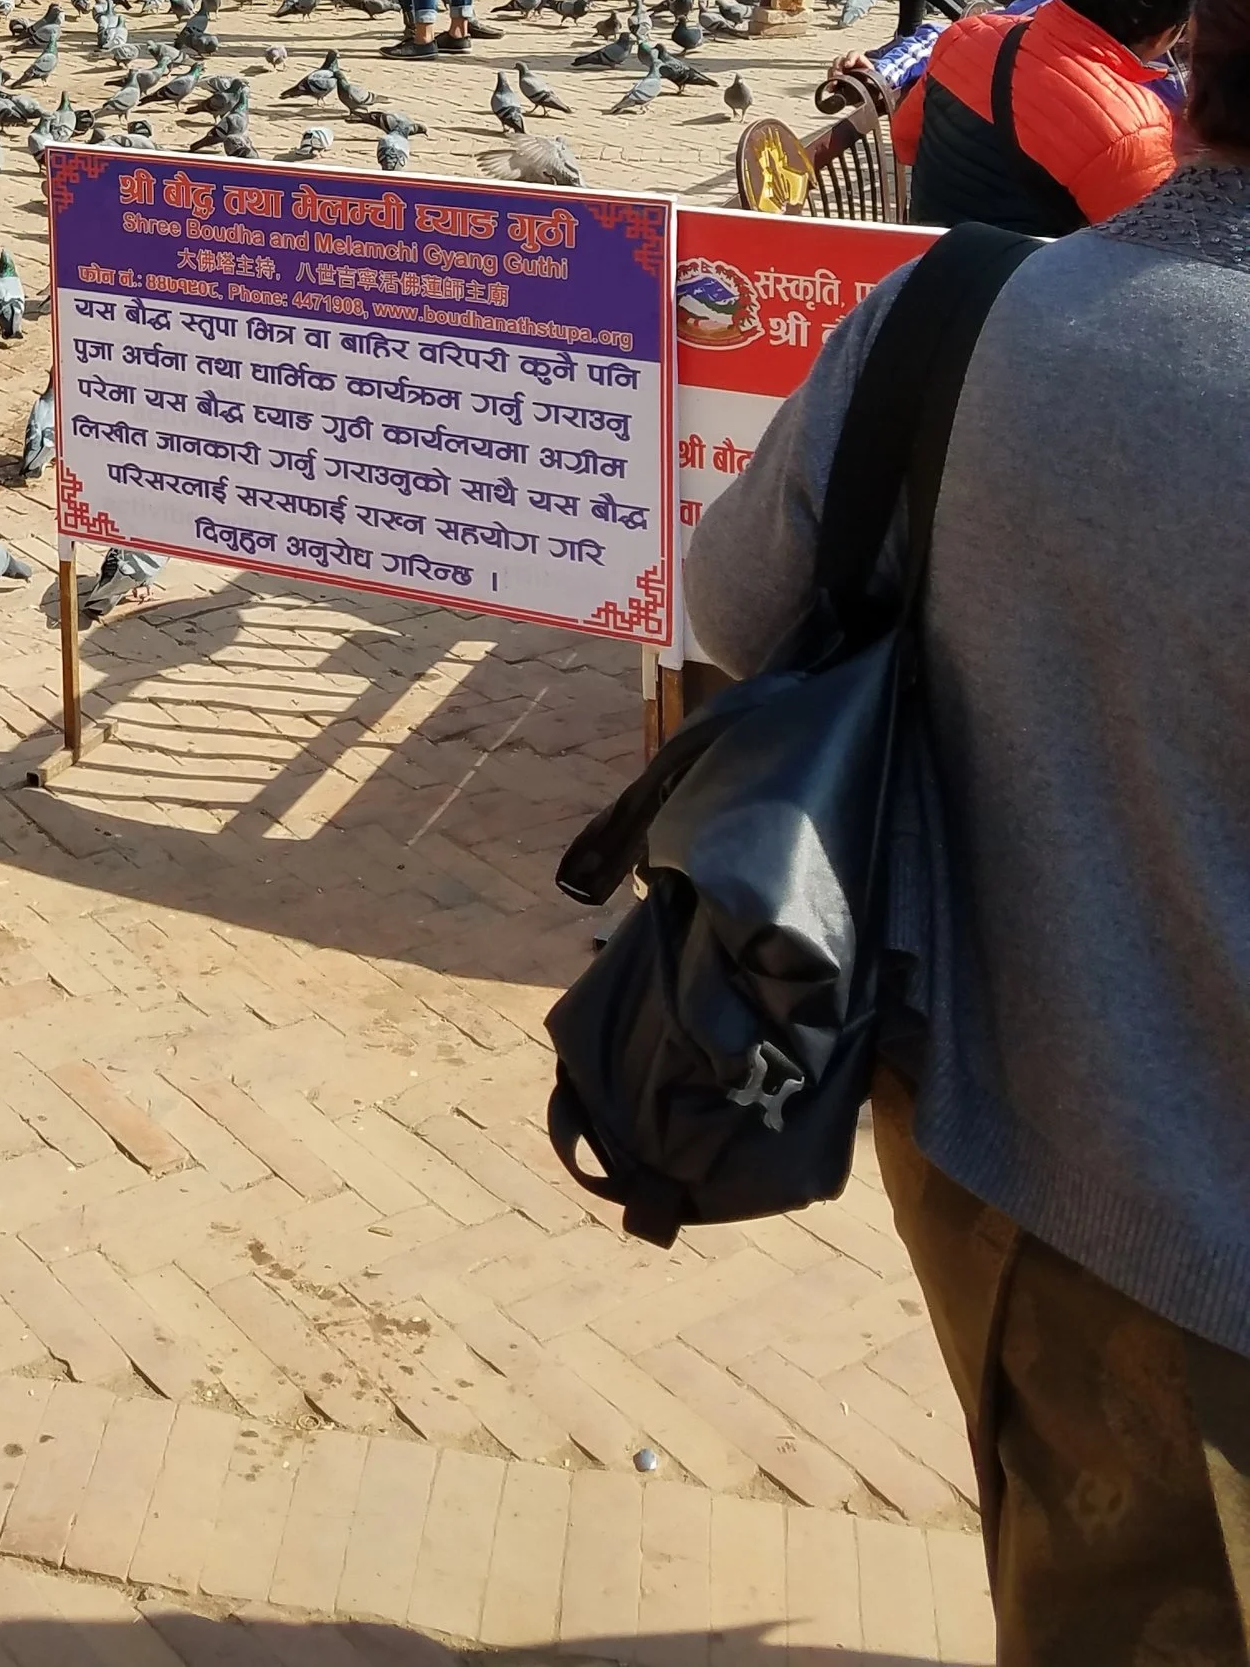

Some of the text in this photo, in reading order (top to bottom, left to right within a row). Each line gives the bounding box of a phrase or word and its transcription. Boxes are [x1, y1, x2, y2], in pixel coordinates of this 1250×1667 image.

[119, 168, 156, 205] श्री
[223, 185, 284, 218] तथा
[292, 184, 407, 230] मेलम्ची
[507, 208, 579, 252] गुठी
[122, 212, 569, 280] Shree Boudha and Melamchi Gyang Guthi
[77, 262, 116, 285] फोन
[228, 283, 288, 307] Phone:
[291, 290, 369, 320] 4471908,
[373, 301, 634, 352] www.boudhanathstupa.org
[754, 267, 845, 311] संस्कृति,
[769, 311, 811, 347] श्री
[74, 297, 641, 390] यस बौद्ध स्तुपा भित्र वा बाहिर वरिपरी कुनै पनि
[73, 337, 632, 441] पुजा अर्चना तथा धार्मिक कार्यक्रम गर्नु गराउनु
[77, 374, 136, 405] परेमा
[144, 388, 188, 413] यस
[195, 390, 245, 424] बौद्ध
[321, 414, 374, 443] गुठी
[381, 424, 530, 464] कार्यलयमा
[539, 447, 628, 479] अग्रीम
[71, 415, 650, 530] लिखीत जानकारी गर्नु गराउनुको साथै यस बौद्ध
[679, 434, 706, 469] श्री
[107, 462, 605, 566] परिसरलाई सरसफाई राख्न सहयोग गरि
[194, 516, 278, 554] दिनुहुन
[287, 536, 373, 569] अनुरोध
[381, 552, 474, 586] गरिन्छ
